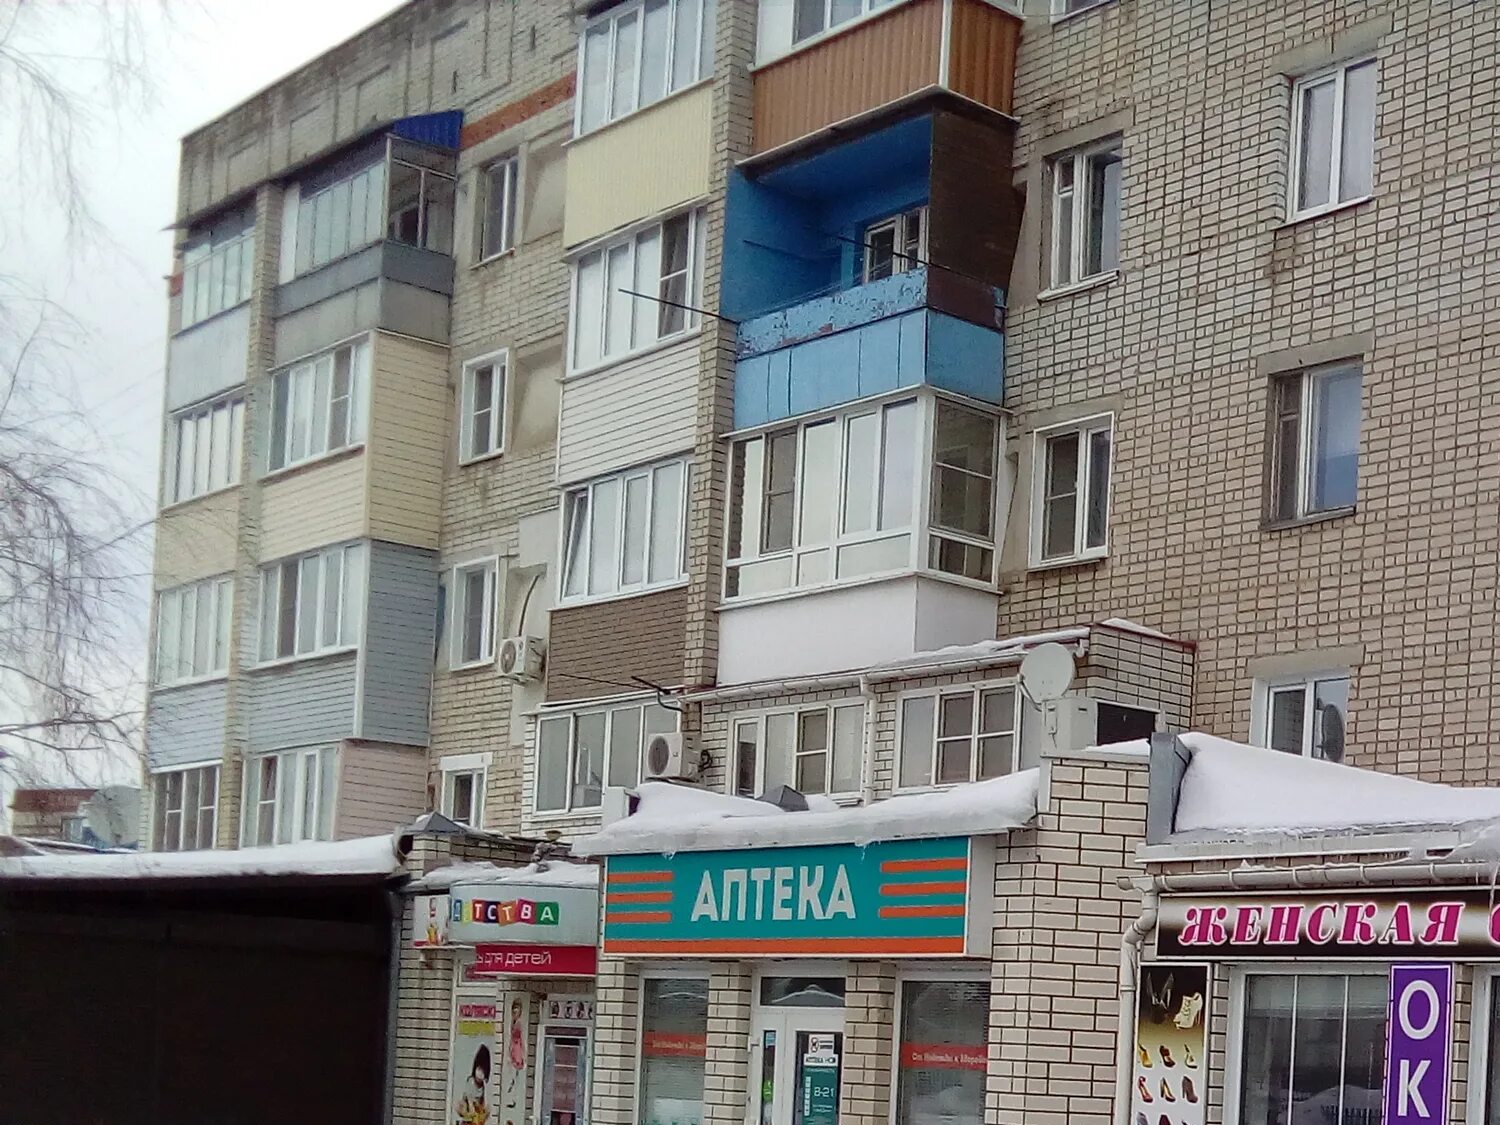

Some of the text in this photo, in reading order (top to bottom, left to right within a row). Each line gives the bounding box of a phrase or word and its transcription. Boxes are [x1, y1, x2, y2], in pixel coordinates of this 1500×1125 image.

[690, 863, 858, 923] АПТЕКА
[1178, 899, 1461, 947] ЖЕНСКАЯ
[504, 950, 552, 968] детей
